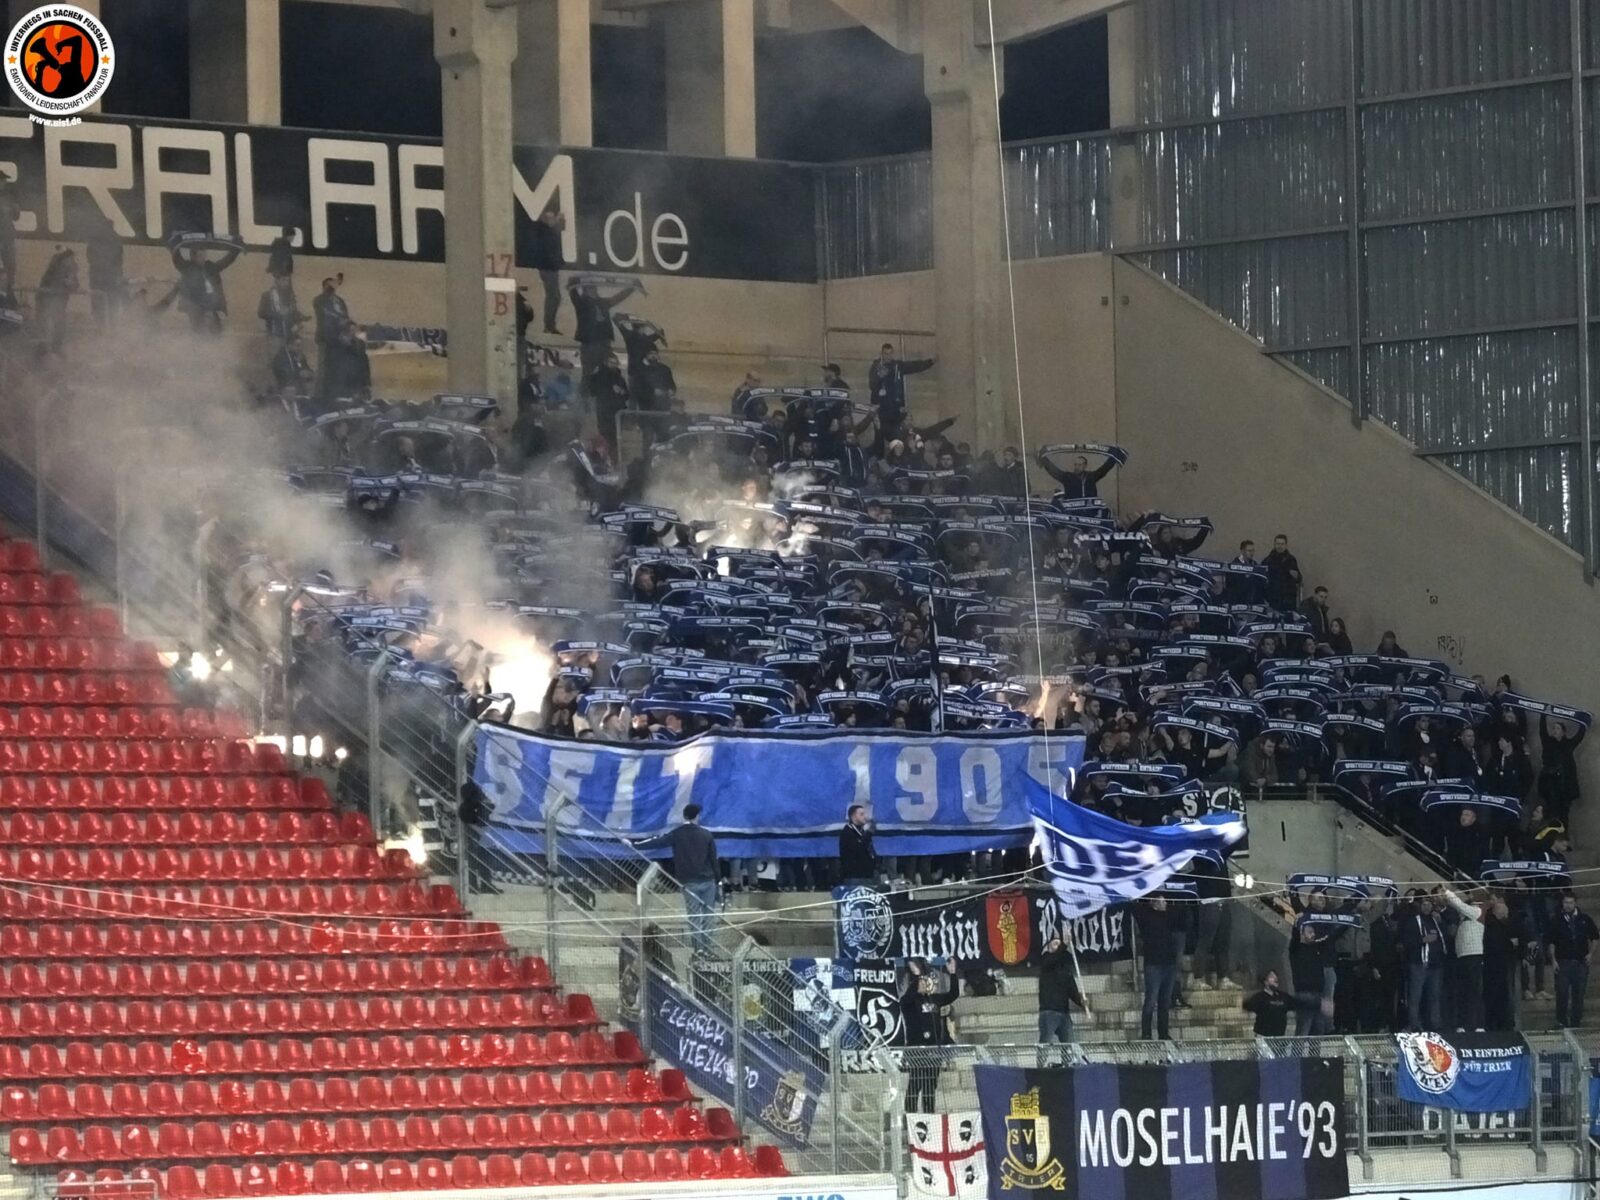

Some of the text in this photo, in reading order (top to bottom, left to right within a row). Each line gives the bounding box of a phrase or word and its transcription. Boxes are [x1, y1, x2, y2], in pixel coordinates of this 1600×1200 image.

[485, 254, 514, 278] 17
[494, 291, 508, 316] B
[853, 968, 896, 984] FREUND
[1007, 1169, 1056, 1185] TRIER
